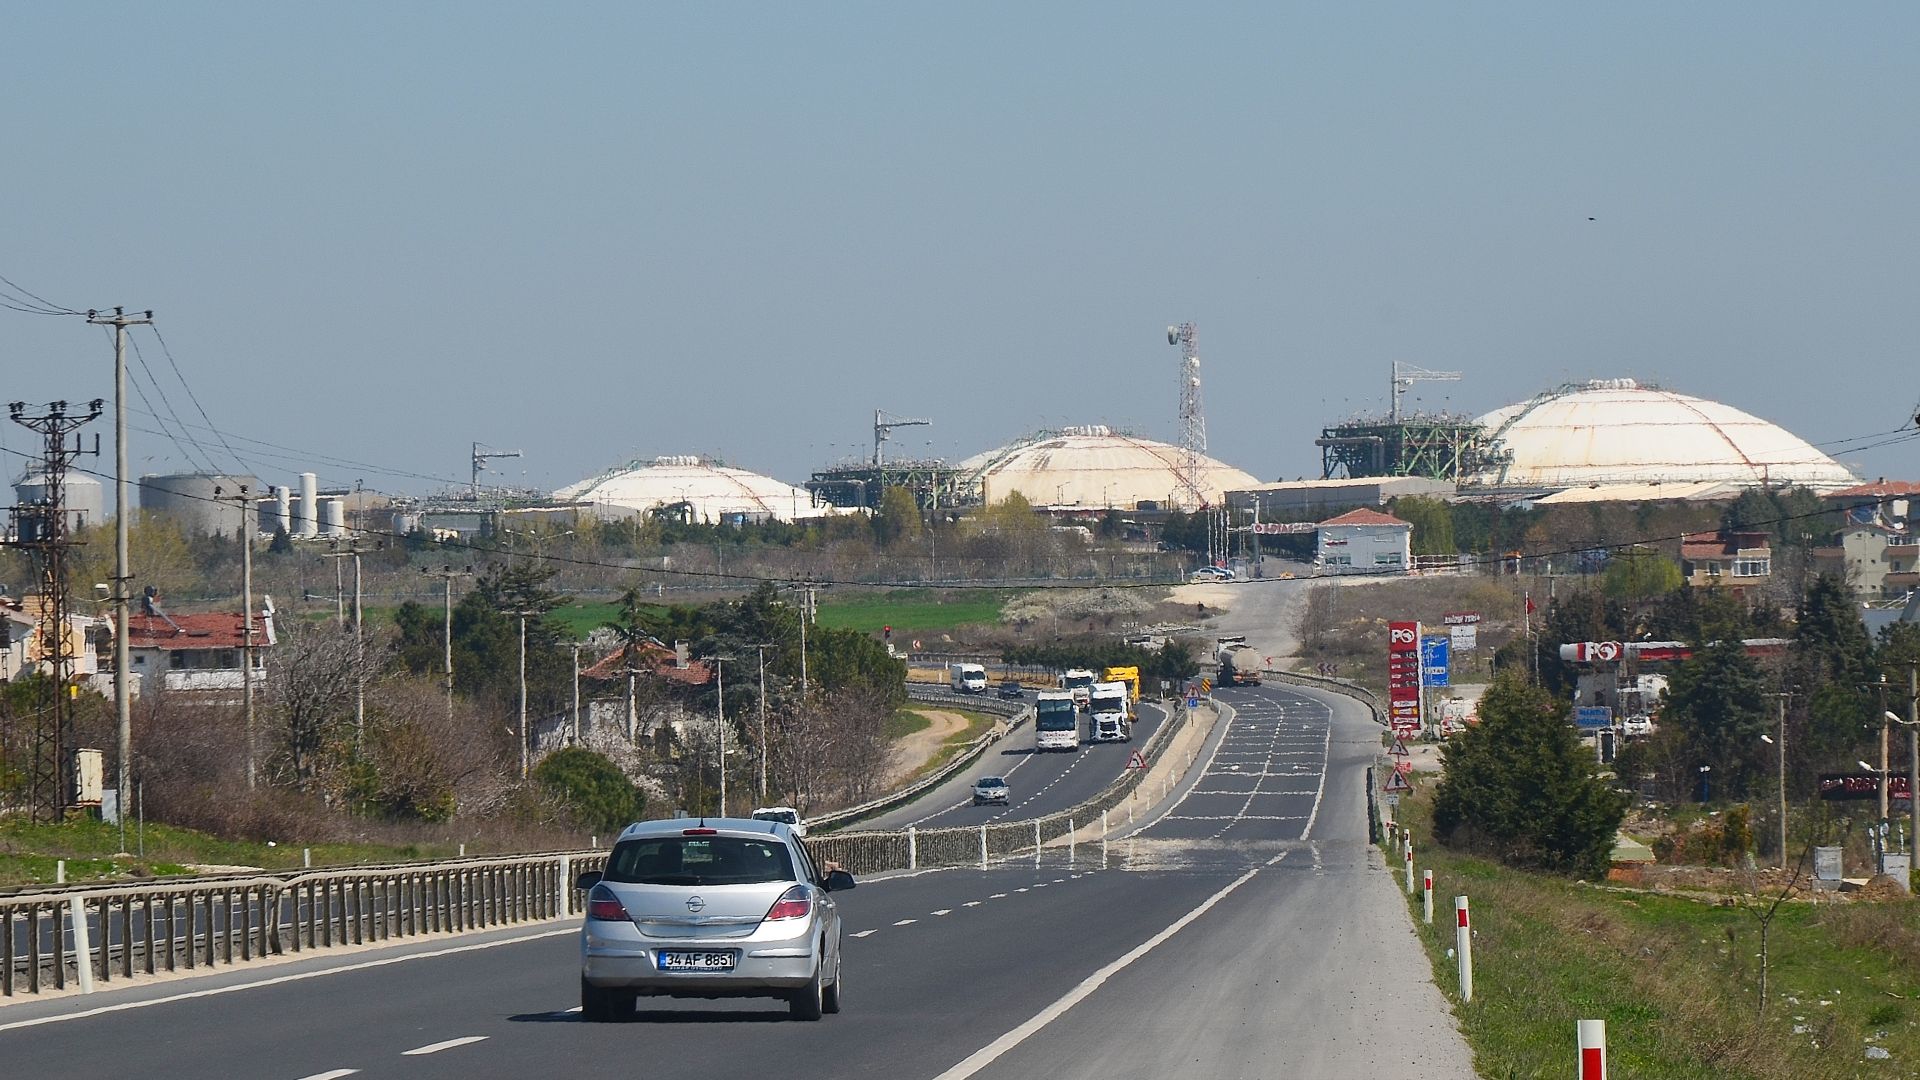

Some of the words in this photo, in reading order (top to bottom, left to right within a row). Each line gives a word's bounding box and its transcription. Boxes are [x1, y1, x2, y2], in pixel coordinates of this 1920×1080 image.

[1391, 629, 1415, 643] PO
[667, 954, 681, 965] 34
[685, 954, 702, 965] AF
[705, 954, 733, 966] 8851
